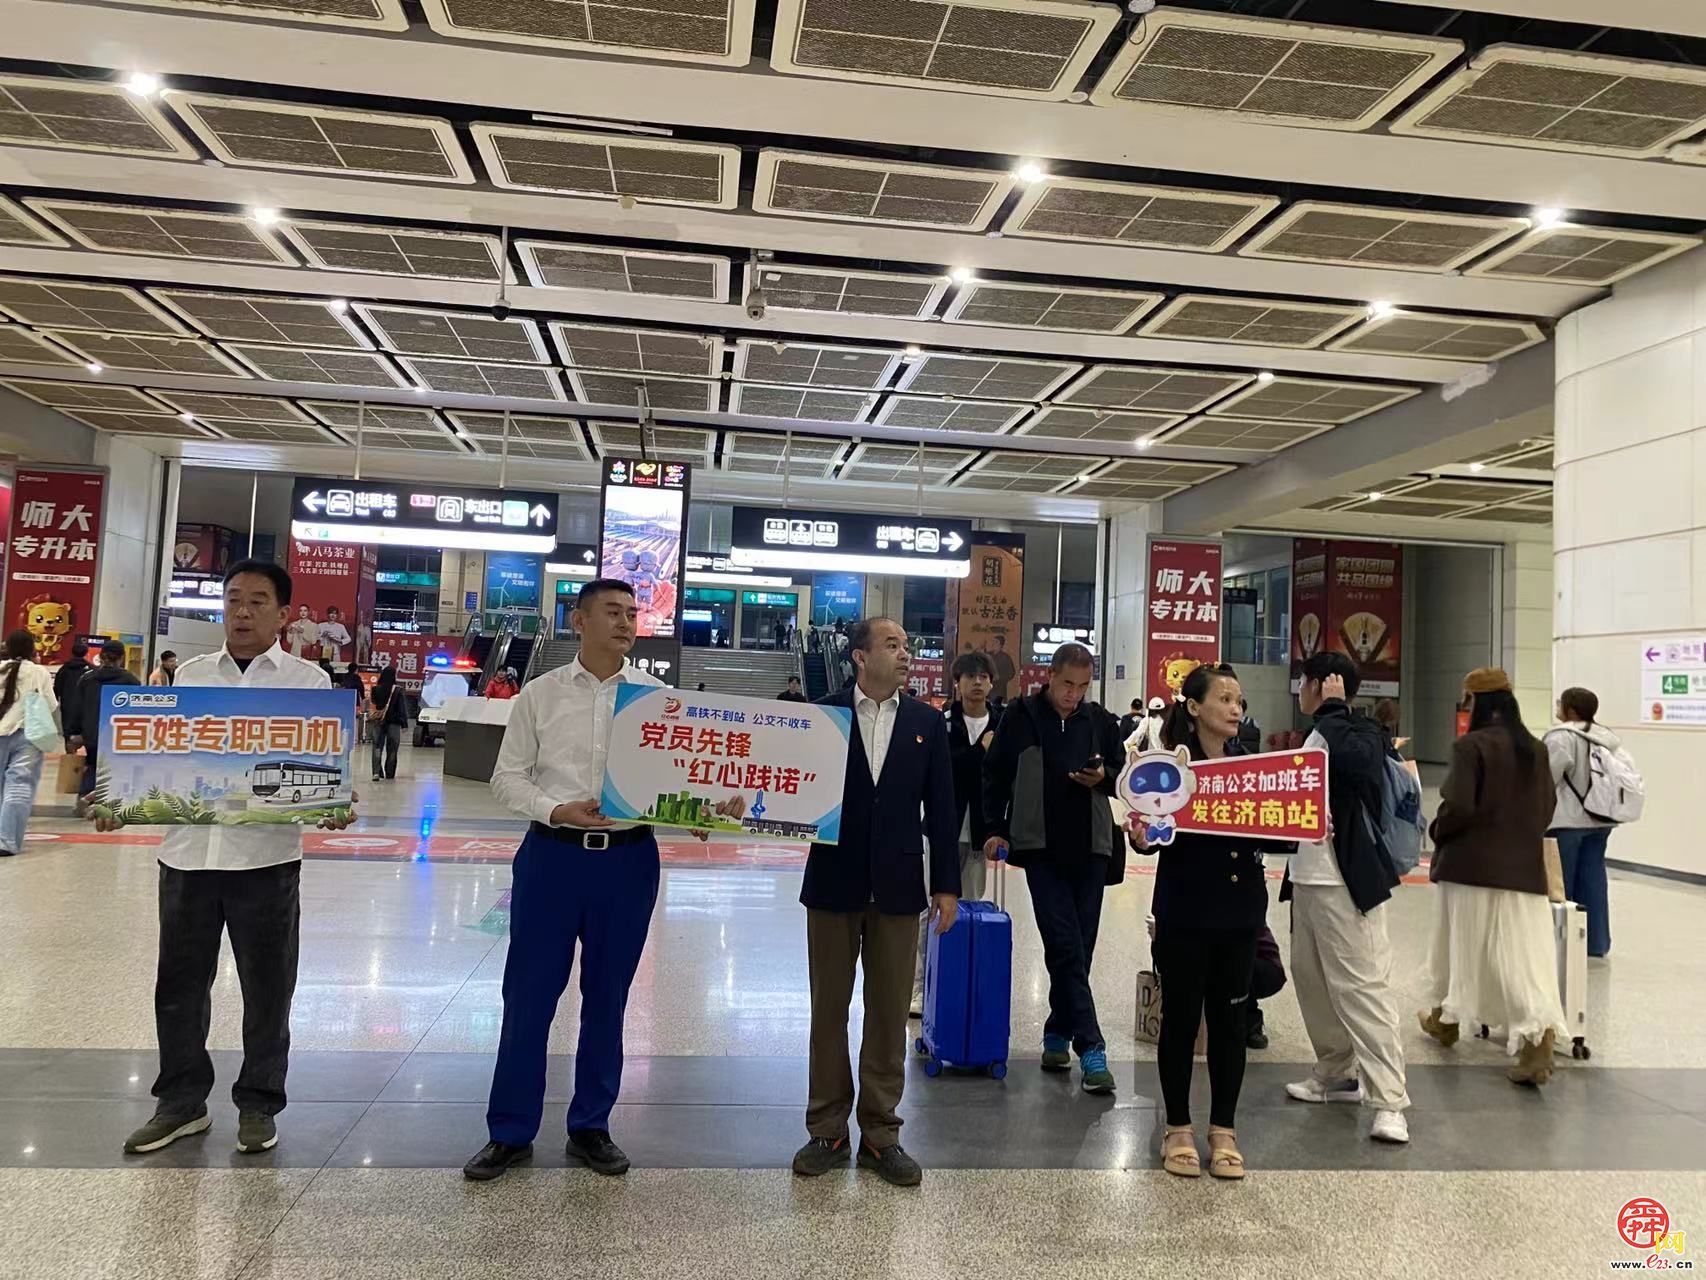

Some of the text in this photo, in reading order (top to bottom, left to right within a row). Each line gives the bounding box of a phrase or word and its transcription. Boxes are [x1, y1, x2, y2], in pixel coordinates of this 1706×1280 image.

[355, 492, 398, 508] 出租车
[21, 501, 93, 531] 师大
[12, 535, 97, 561] 专升本
[312, 546, 356, 559] 八马茶业
[1156, 568, 1215, 596] 师大
[1150, 599, 1219, 623] 专升本
[686, 706, 812, 730] 高铁不到站 公交不收车
[112, 716, 342, 754] 百姓专职司机
[639, 722, 752, 758] 党员先锋
[673, 758, 816, 794] “红心践诺”
[1198, 766, 1321, 794] 济南公交加班车
[1192, 799, 1319, 829] 发往济南站
